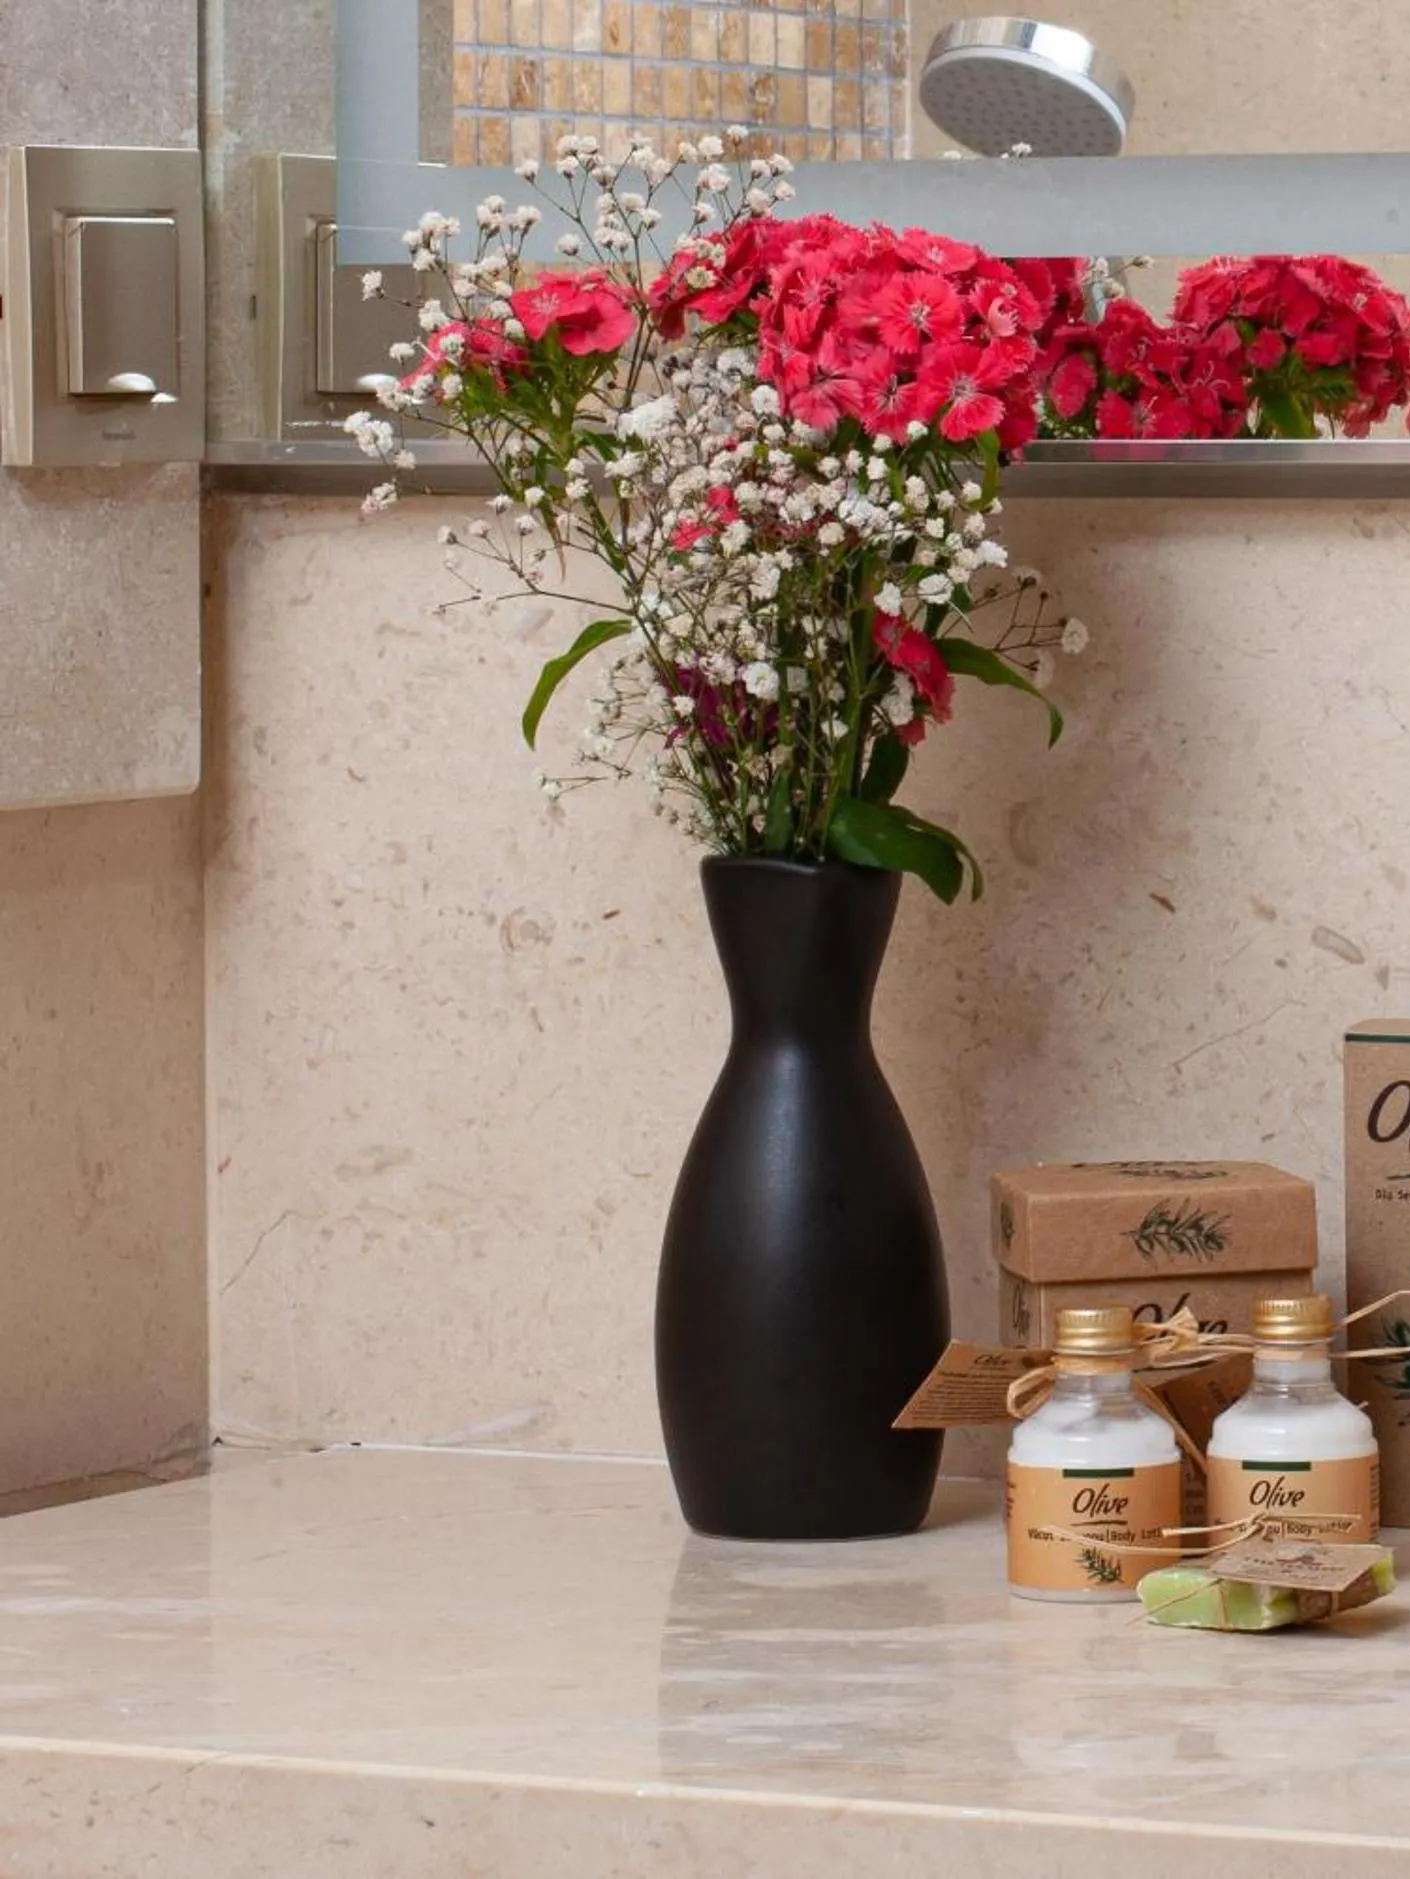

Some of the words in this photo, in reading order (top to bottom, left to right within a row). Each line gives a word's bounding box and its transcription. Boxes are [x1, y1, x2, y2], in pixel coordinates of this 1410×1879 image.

[1072, 1483, 1129, 1518] Olive
[1250, 1475, 1305, 1509] Olive
[1141, 1528, 1163, 1540] Loti
